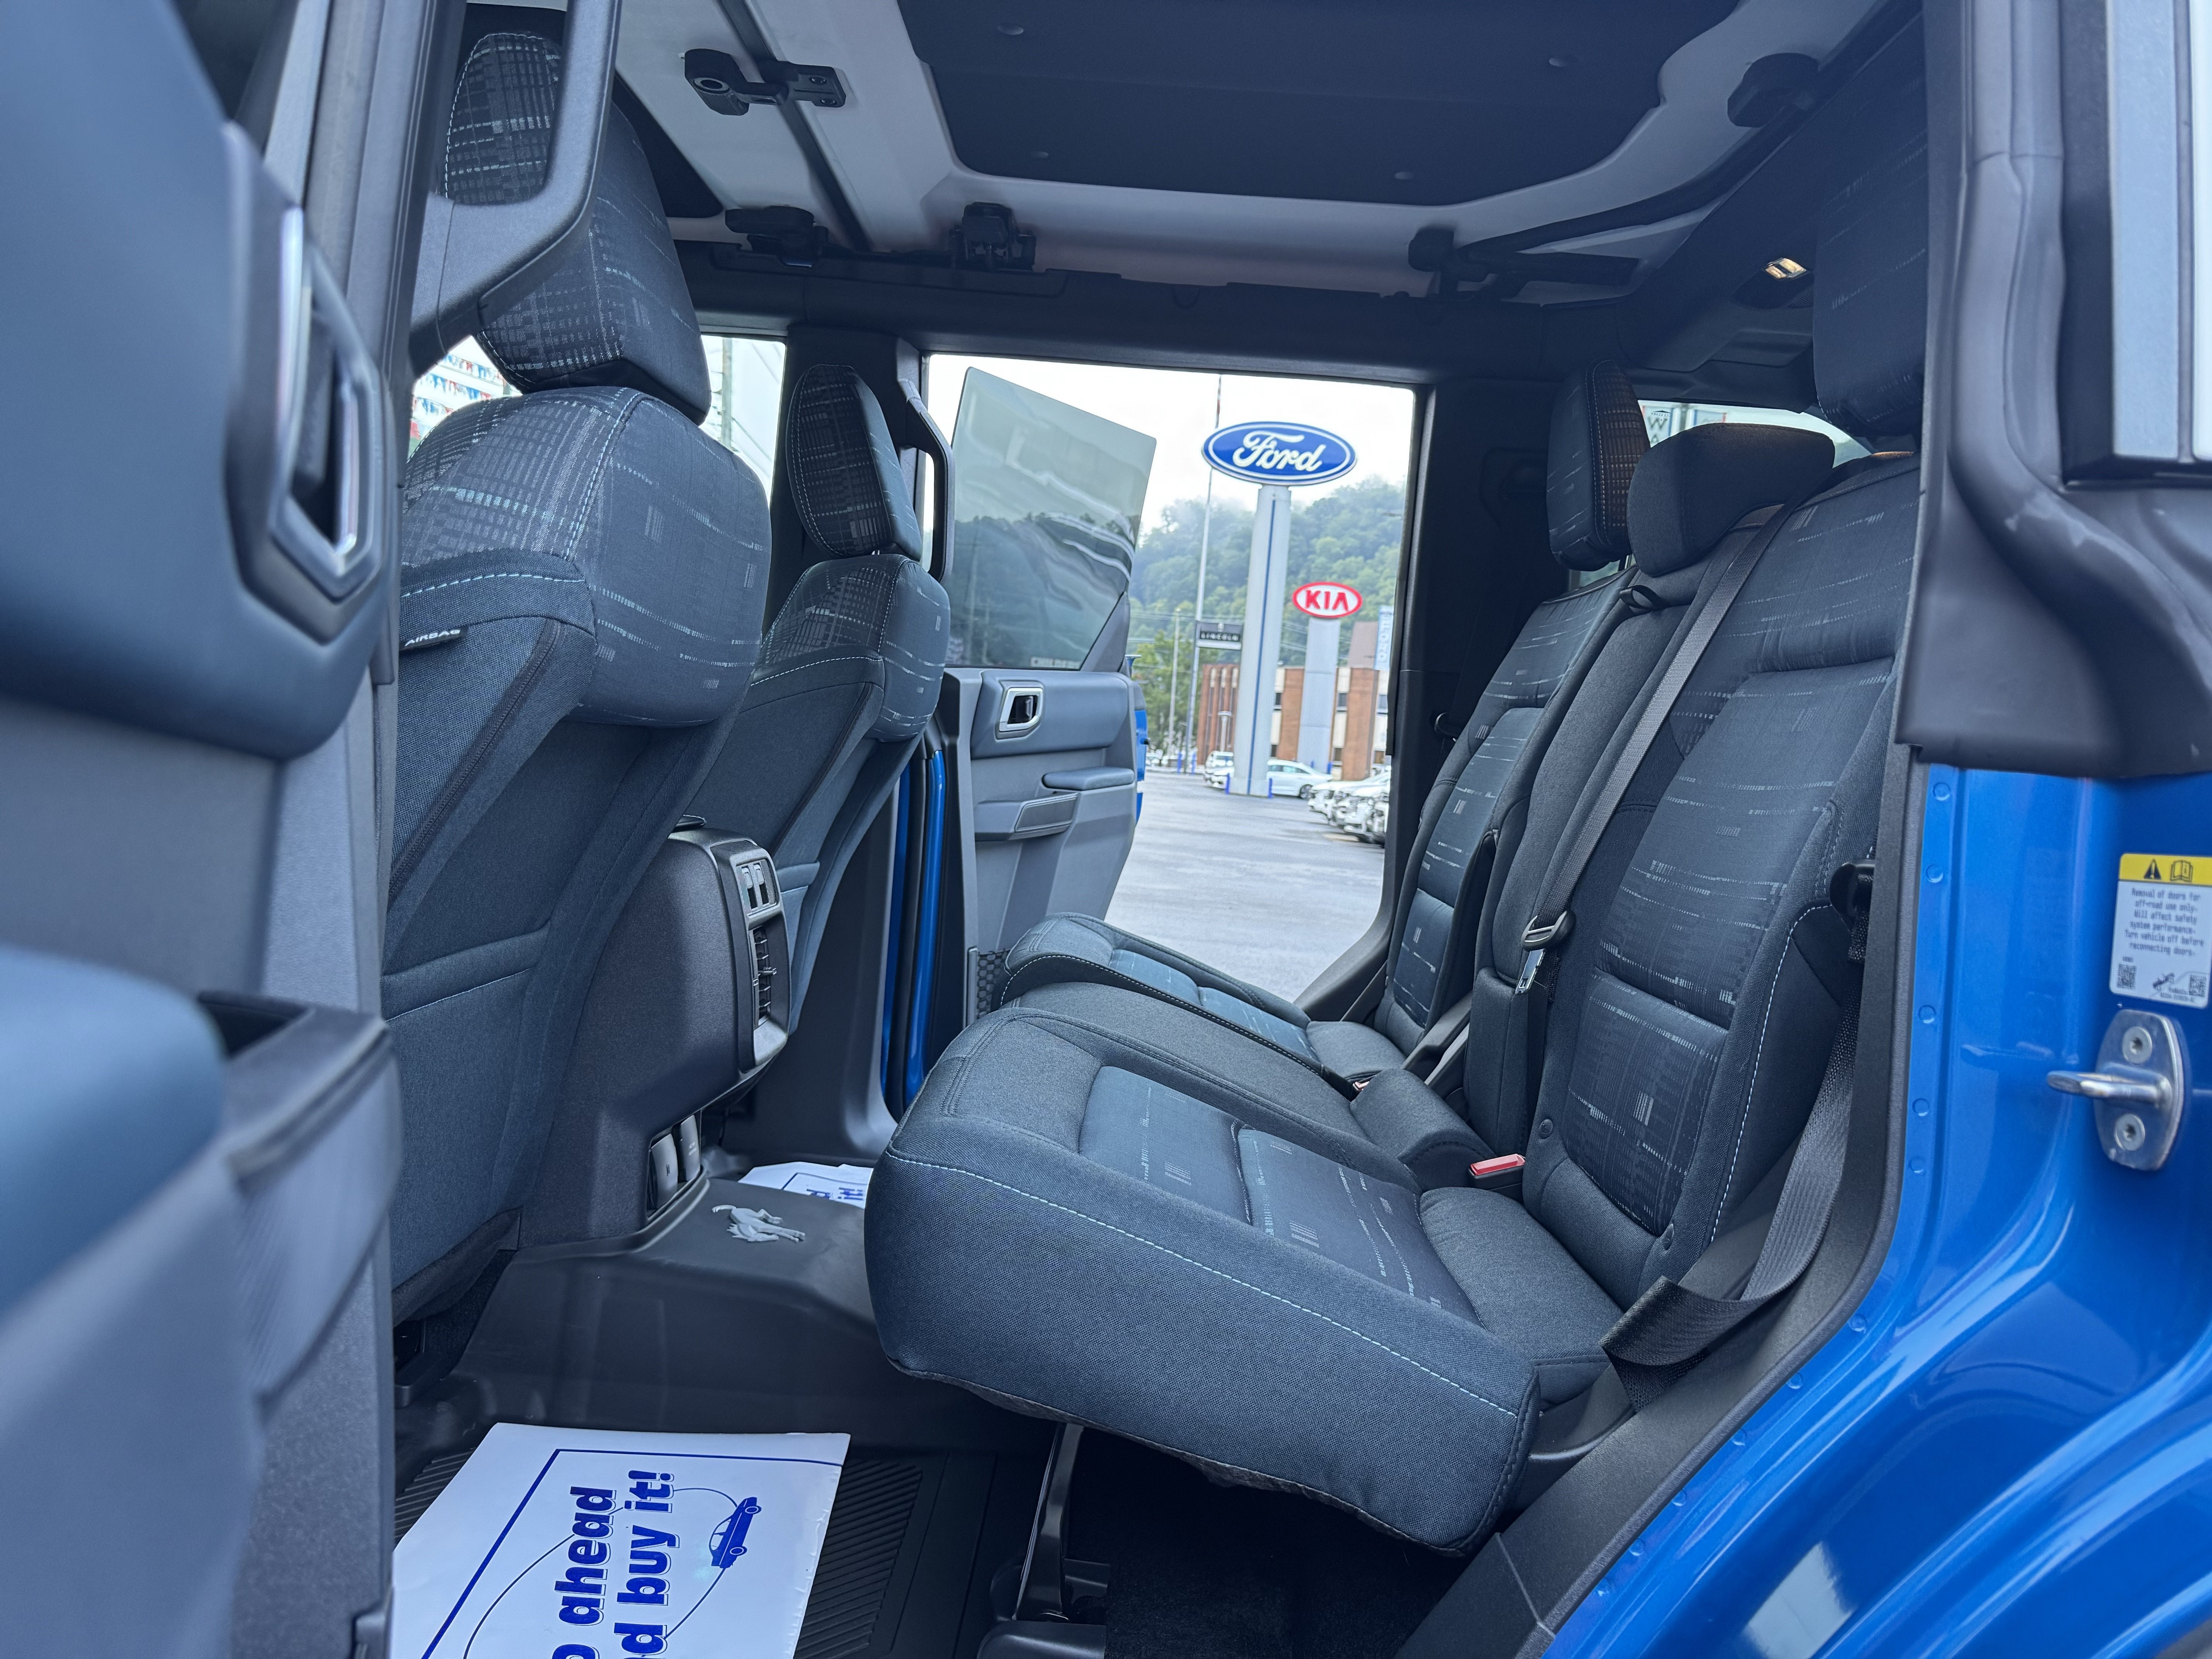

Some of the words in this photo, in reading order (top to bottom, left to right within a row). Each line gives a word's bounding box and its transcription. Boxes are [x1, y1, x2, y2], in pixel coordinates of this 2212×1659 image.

[1232, 431, 1326, 471] Ford
[1305, 590, 1348, 611] KIA
[405, 630, 460, 646] AIRBAG
[2132, 888, 2155, 898] Removal
[2158, 890, 2164, 898] of
[2168, 891, 2186, 900] doors
[2189, 892, 2201, 901] for
[2135, 900, 2163, 909] off-road
[2180, 903, 2198, 913] only.
[2134, 909, 2147, 919] Will
[2151, 911, 2171, 921] affect
[2175, 914, 2197, 925] safety
[2130, 921, 2150, 930] system
[2153, 924, 2195, 934] performance.
[2125, 929, 2138, 939] Turn
[2141, 932, 2165, 942] vehicle
[2167, 935, 2178, 943] off
[2181, 936, 2204, 946] before
[2129, 943, 2171, 955] reconnecting
[624, 1470, 675, 1513] it!
[555, 1486, 616, 1626] ahead
[617, 1525, 680, 1606] buy
